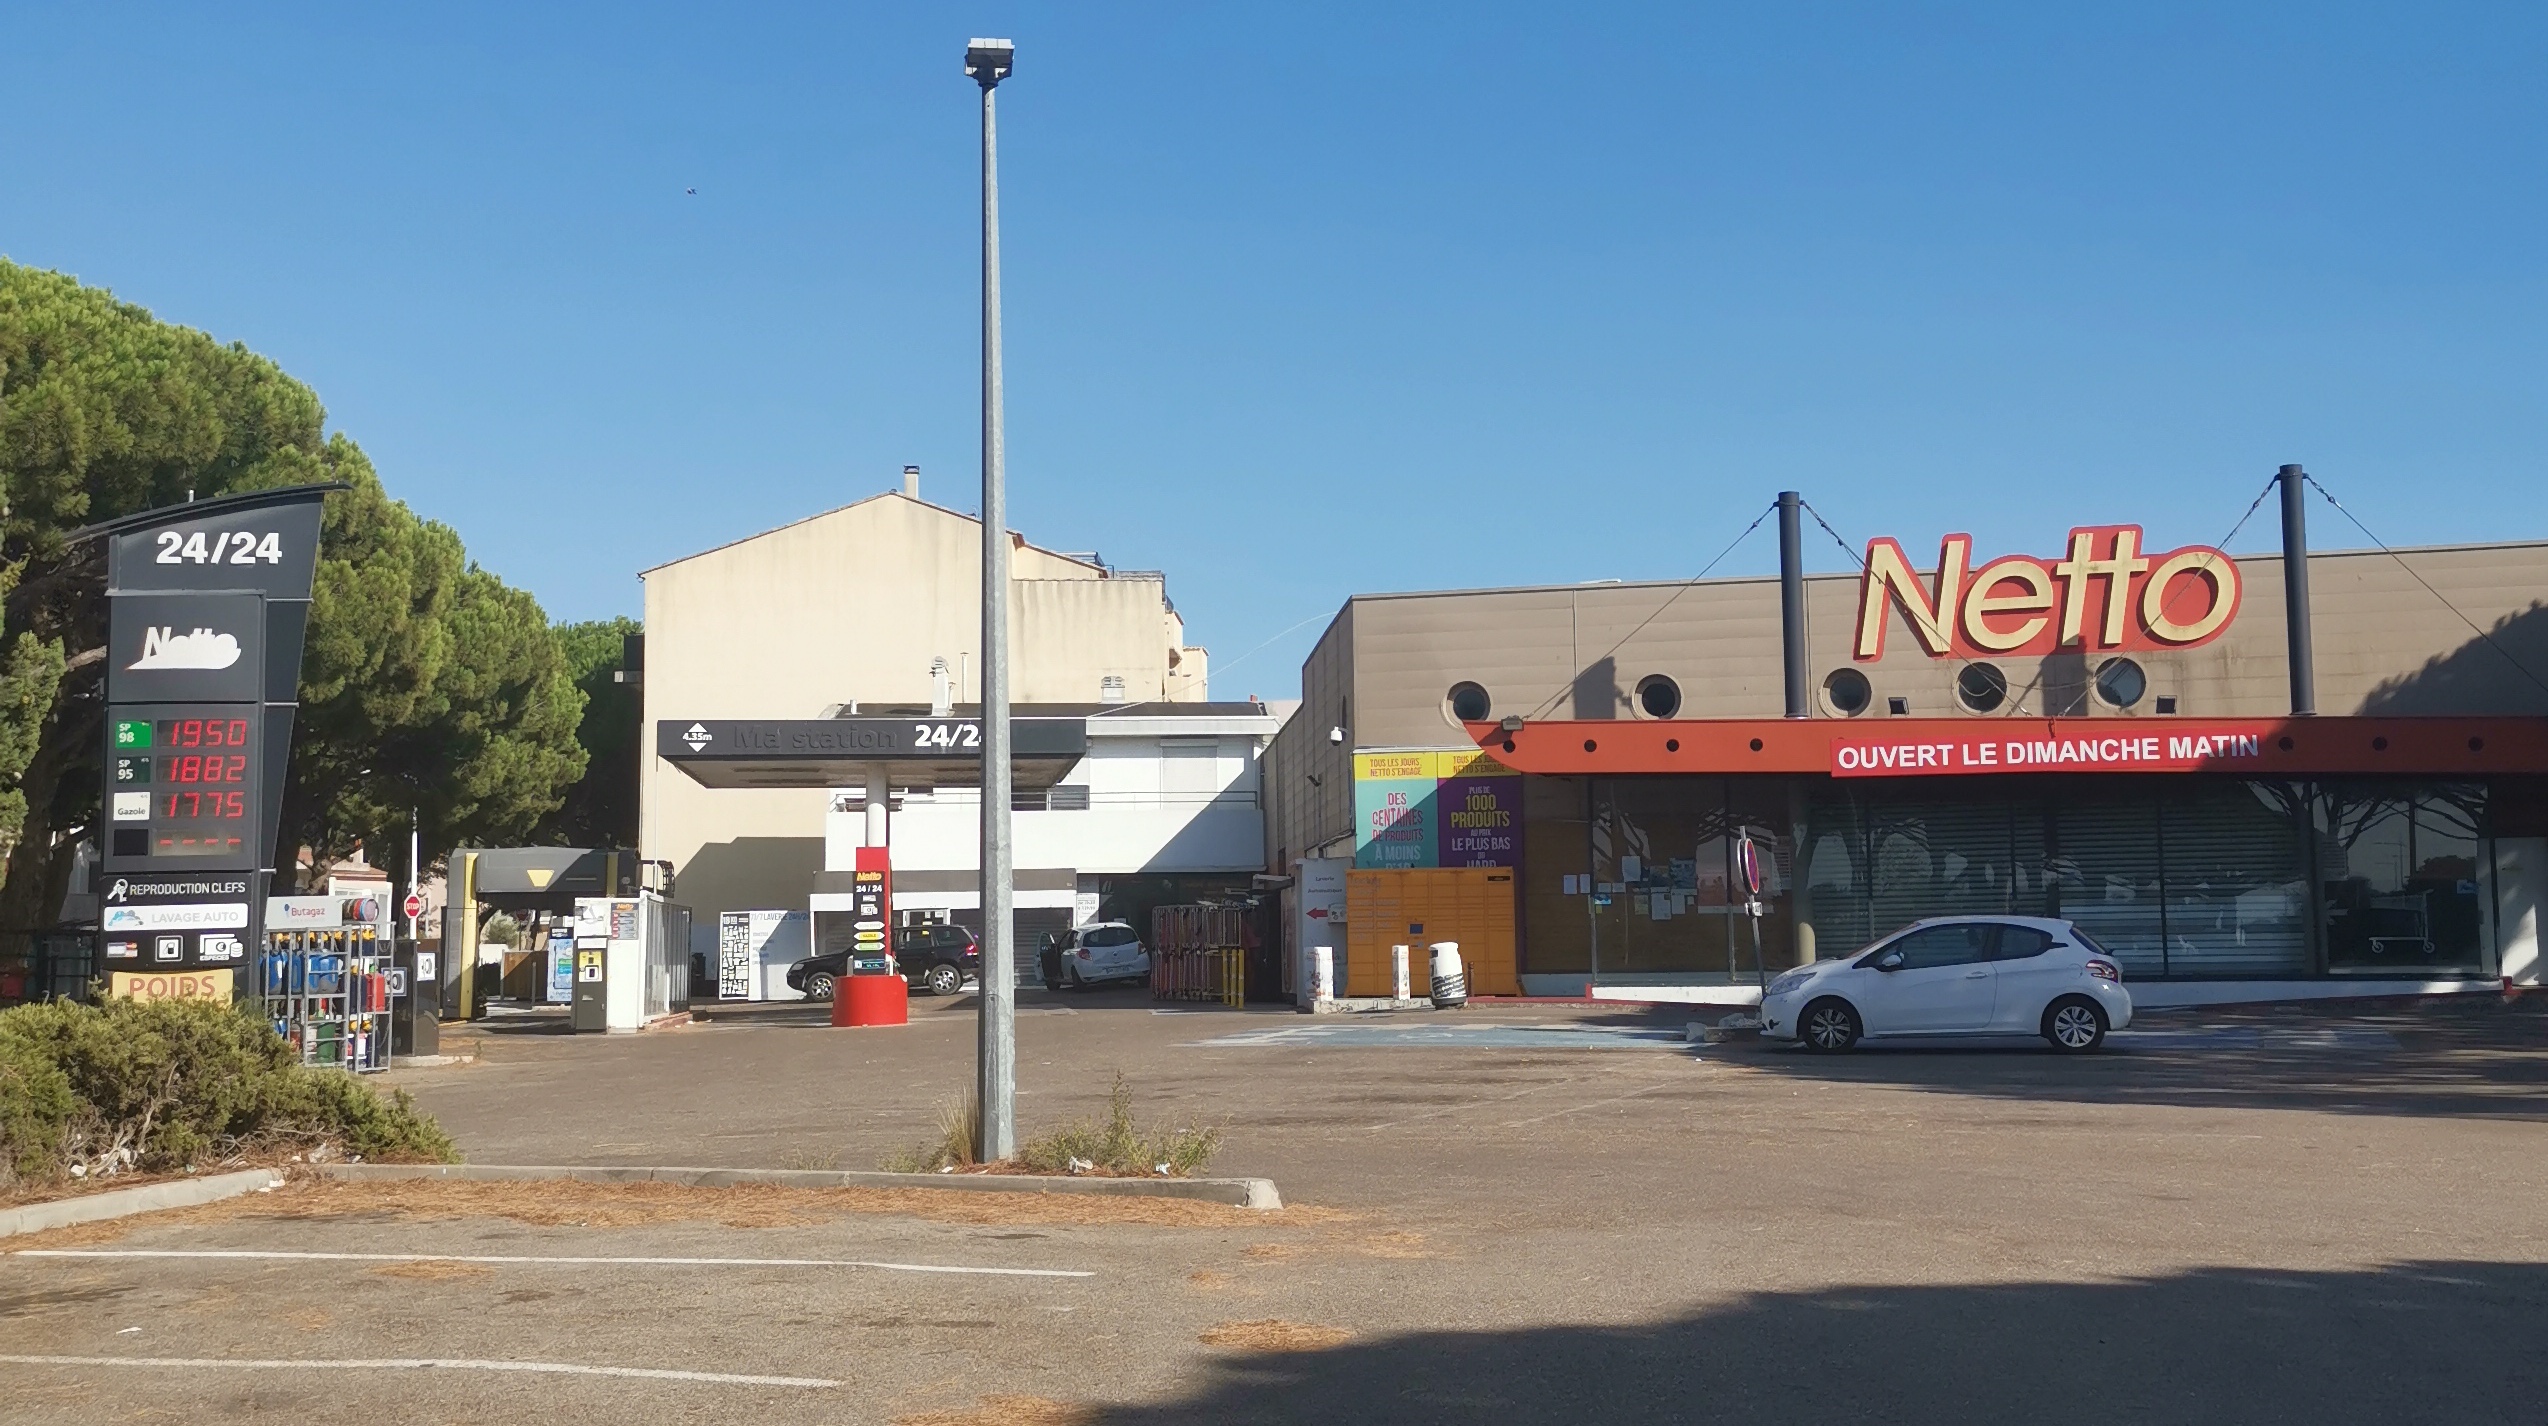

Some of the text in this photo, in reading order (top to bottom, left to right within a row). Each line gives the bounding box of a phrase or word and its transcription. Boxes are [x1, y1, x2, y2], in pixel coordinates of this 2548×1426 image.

[156, 531, 282, 564] 24/24
[1859, 530, 2236, 656] Netto
[118, 723, 131, 732] SP
[171, 720, 247, 748] 1950
[118, 732, 135, 743] 98
[682, 732, 712, 741] 4.35m
[735, 724, 982, 749] Ma station 24/2
[1838, 734, 2259, 769] OUVERT LE DIMANCHE MATIN
[118, 759, 131, 768] SP
[1370, 758, 1386, 768] TOUS
[1387, 758, 1399, 767] LES
[1453, 755, 1469, 764] TOUS
[117, 769, 134, 780] 95
[170, 756, 246, 782] 1882
[1370, 767, 1422, 777] NETTO S'ENGAGE
[169, 792, 245, 818] 1775
[1387, 792, 1407, 806] DES
[1465, 794, 1497, 811] 1000
[117, 807, 146, 815] Gazole
[1372, 807, 1423, 828] CENTAINES
[1450, 810, 1511, 829] PRODUITS
[1372, 828, 1424, 842] DE PRODUITS
[1451, 836, 1511, 852] LE PLUS BAS
[1385, 844, 1421, 860] MOINS
[130, 881, 246, 896] REPRODUCTION CLEFS
[291, 907, 326, 918] Butagaz
[406, 902, 420, 910] STOP
[152, 911, 239, 923] LAVAGE AUTO
[129, 976, 216, 999] POIDS
